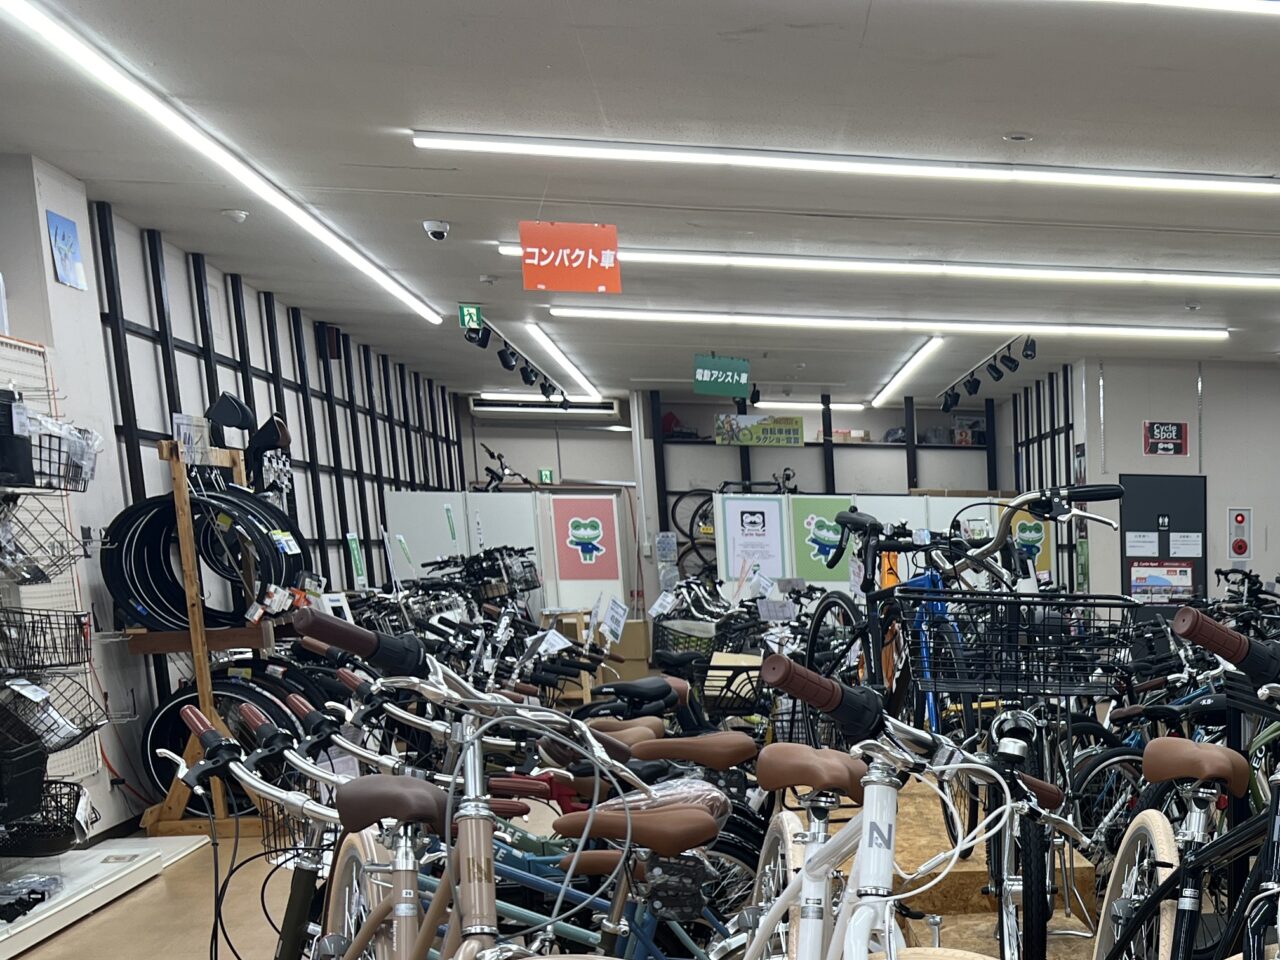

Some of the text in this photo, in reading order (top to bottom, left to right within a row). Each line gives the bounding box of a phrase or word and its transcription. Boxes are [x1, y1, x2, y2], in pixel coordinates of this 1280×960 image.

[524, 247, 615, 269] コンパクト車
[695, 368, 748, 384] 電動アシスト車
[1153, 423, 1178, 432] Cycle
[1153, 430, 1178, 440] Spot
[868, 821, 893, 850] N
